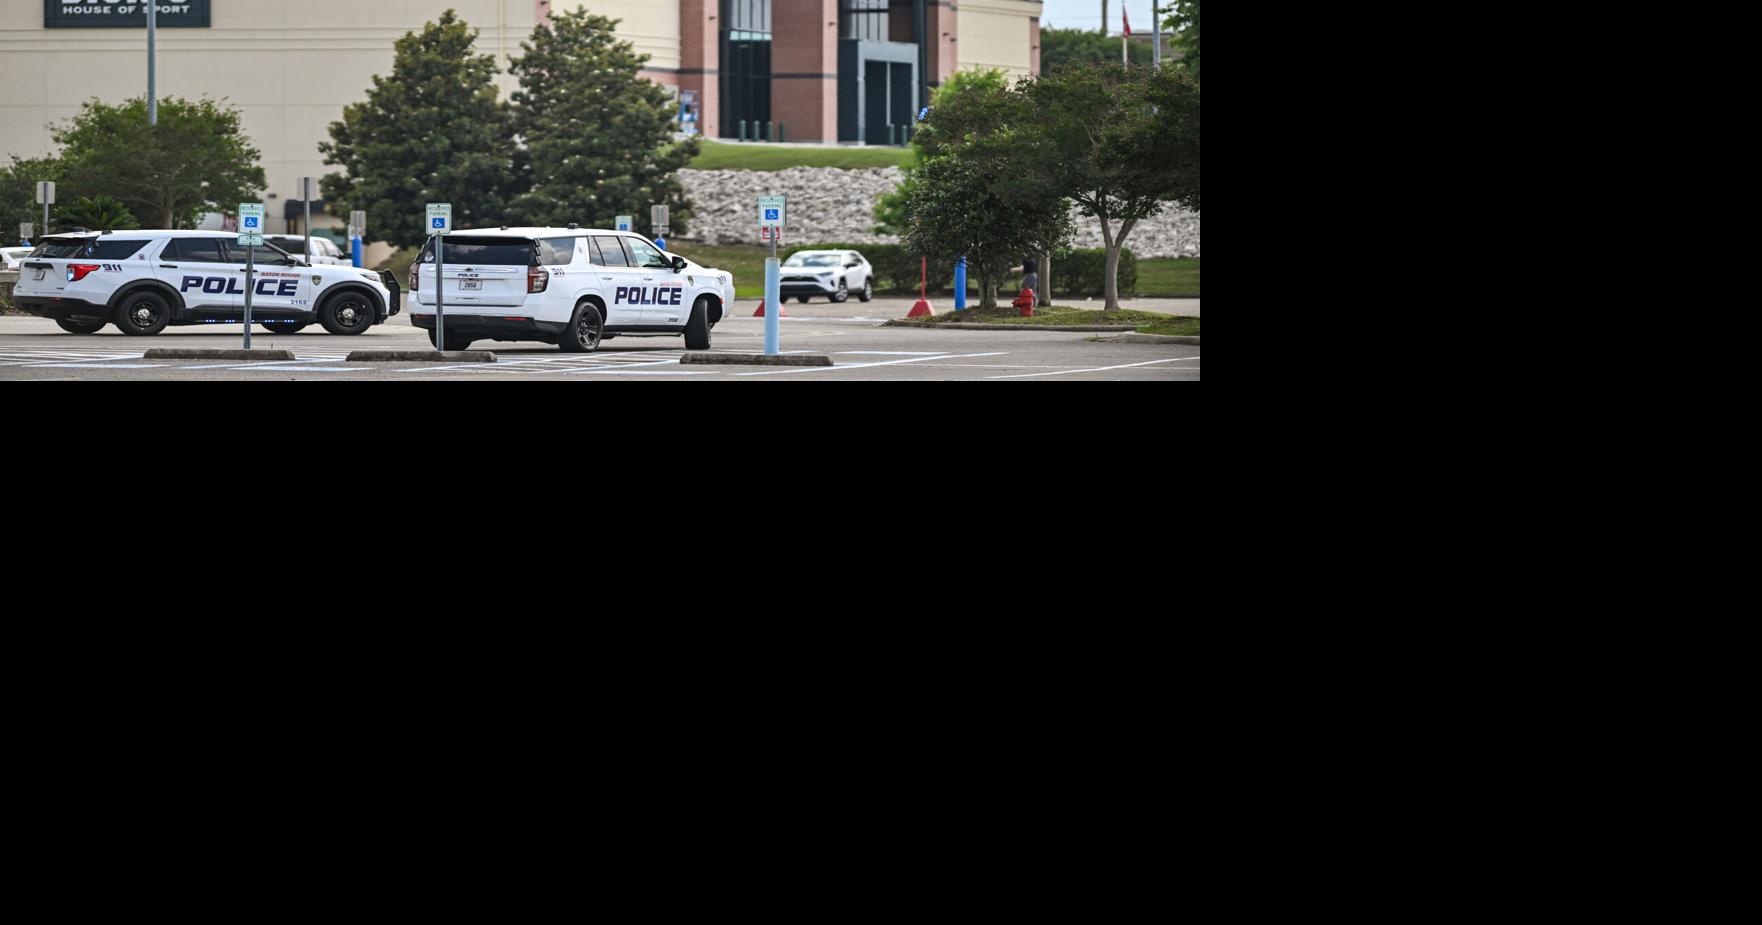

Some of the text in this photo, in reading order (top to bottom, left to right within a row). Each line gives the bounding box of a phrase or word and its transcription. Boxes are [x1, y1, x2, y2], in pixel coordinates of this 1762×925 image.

[62, 5, 111, 14] HOUSE
[117, 5, 137, 14] OF
[102, 263, 122, 271] 911
[180, 276, 298, 296] POLCE
[614, 286, 682, 305] POLICE
